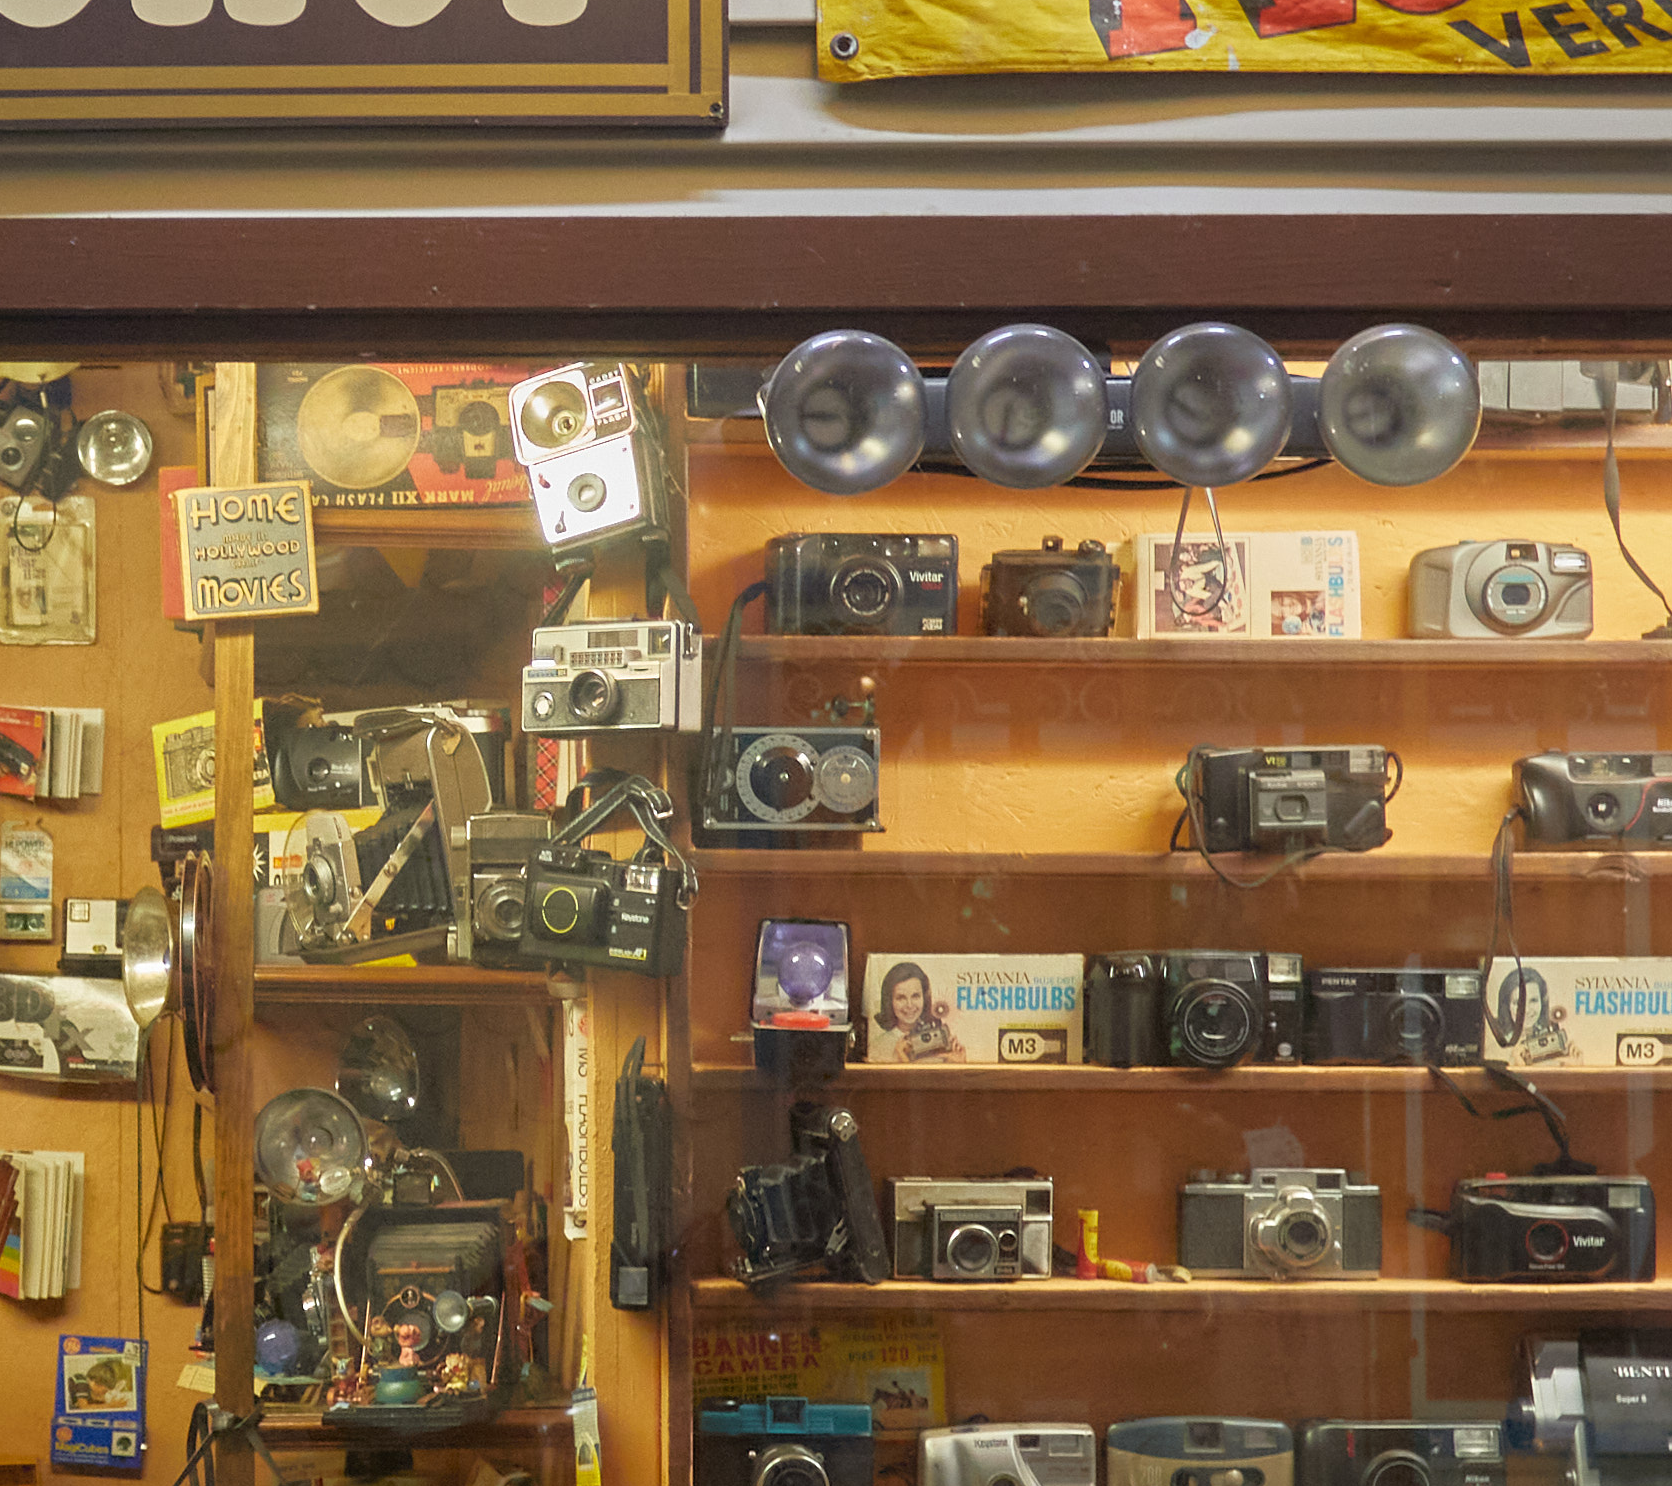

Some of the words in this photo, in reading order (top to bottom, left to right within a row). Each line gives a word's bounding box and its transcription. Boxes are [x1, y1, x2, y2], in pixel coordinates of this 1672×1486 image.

[191, 492, 300, 530] HOME
[195, 540, 300, 561] HOLLYWOOD
[910, 571, 944, 584] Vivitar
[197, 571, 306, 610] MOVIES
[957, 970, 1030, 986] SYLVANIA
[1574, 976, 1651, 990] SYLVANIA
[956, 986, 1076, 1012] FLASHBULBS
[1008, 1038, 1038, 1055] M3
[1625, 1042, 1655, 1059] M3
[1572, 1234, 1606, 1248] Vivitar
[691, 1333, 823, 1358] BANNER
[693, 1354, 821, 1375] CAMERA
[55, 1441, 111, 1457] MagiCubes
